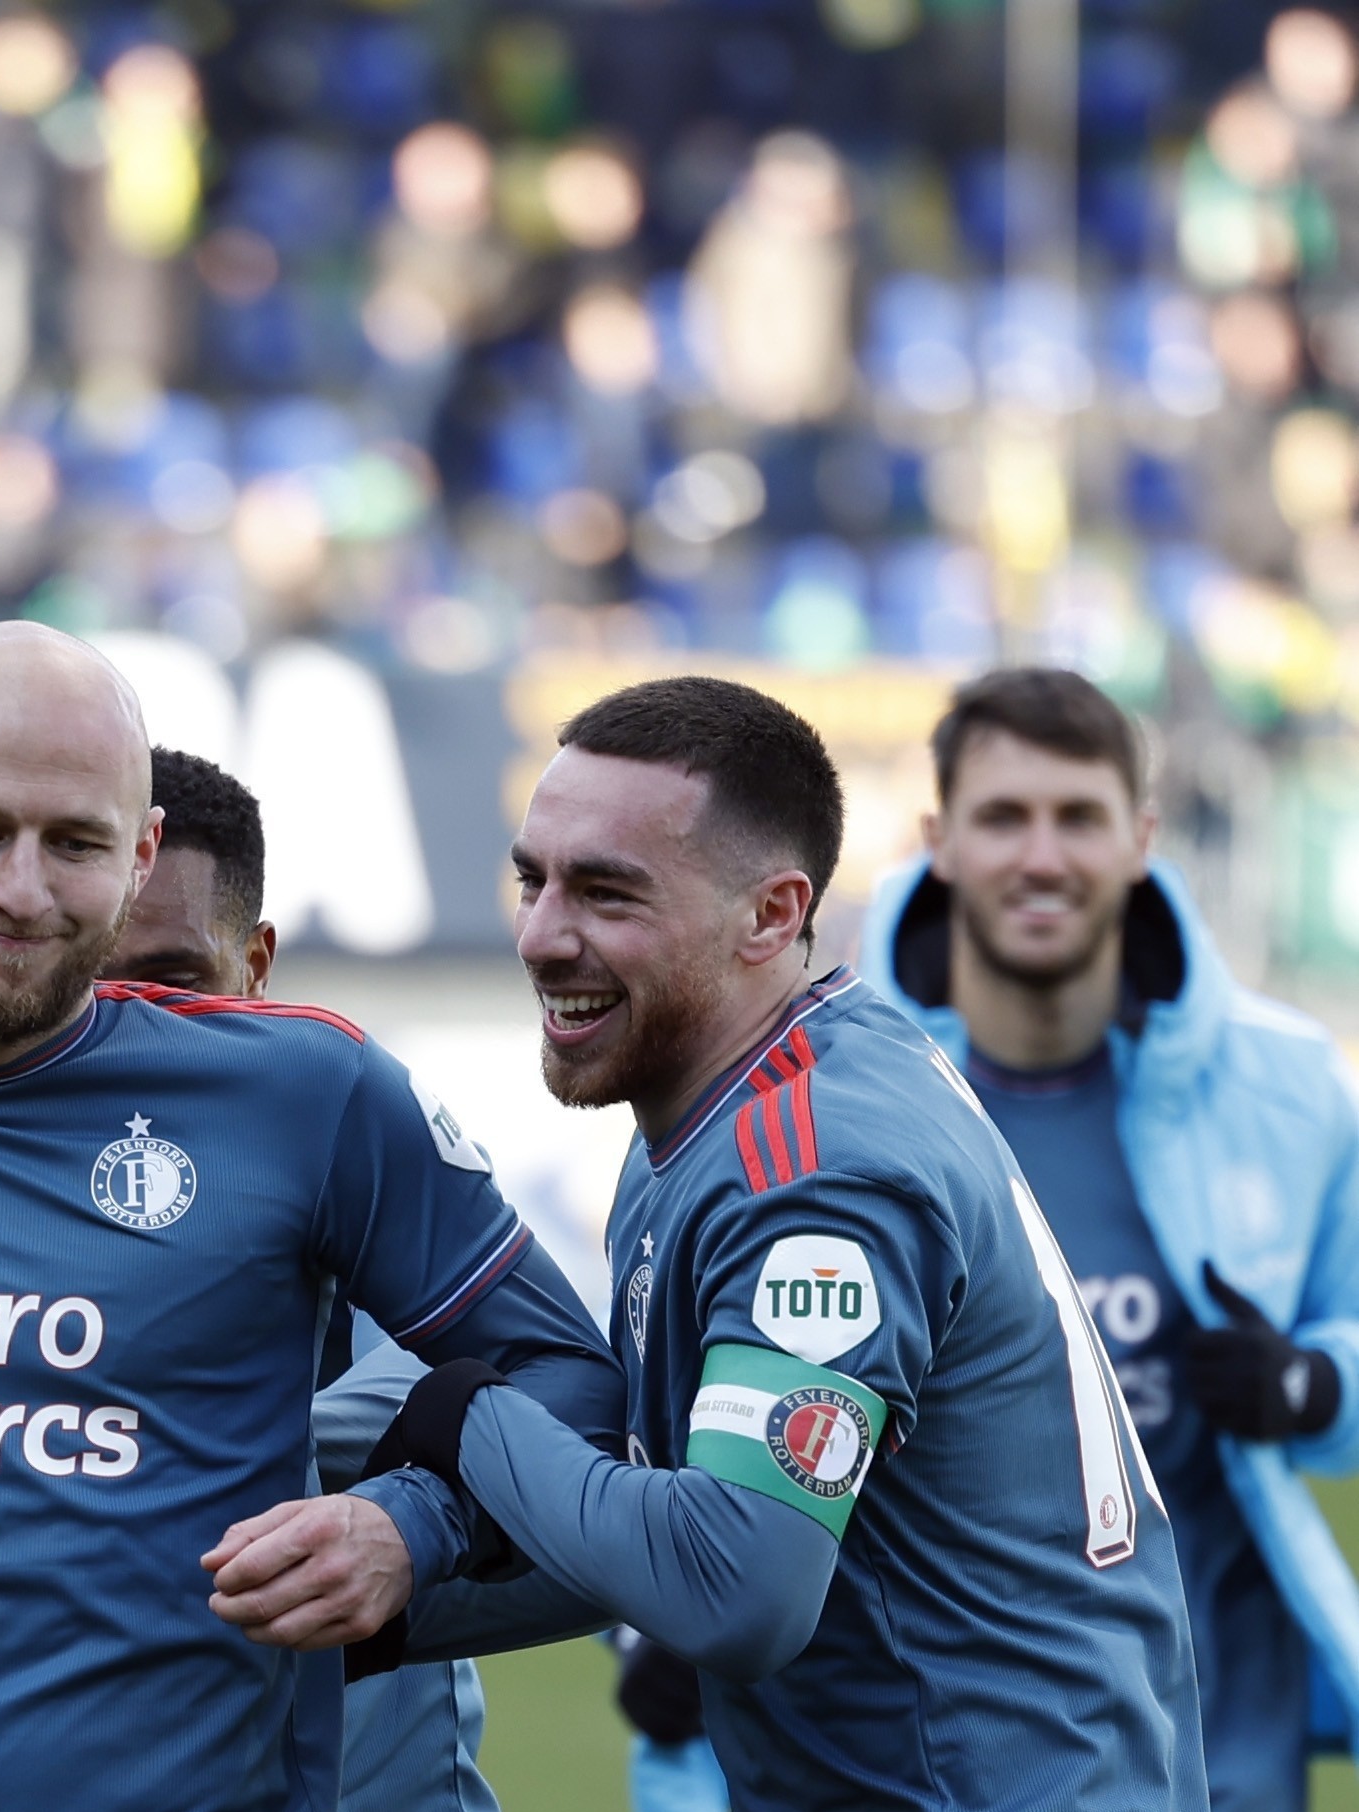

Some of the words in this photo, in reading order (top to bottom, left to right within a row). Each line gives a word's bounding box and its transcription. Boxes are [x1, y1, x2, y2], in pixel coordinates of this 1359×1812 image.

[98, 1141, 188, 1172] FEYENOORD
[99, 1193, 189, 1228] ROTTERDAM
[765, 1279, 862, 1321] TOTO
[783, 1390, 870, 1450] FEYENOORD
[770, 1435, 853, 1497] ROTTERDAM
